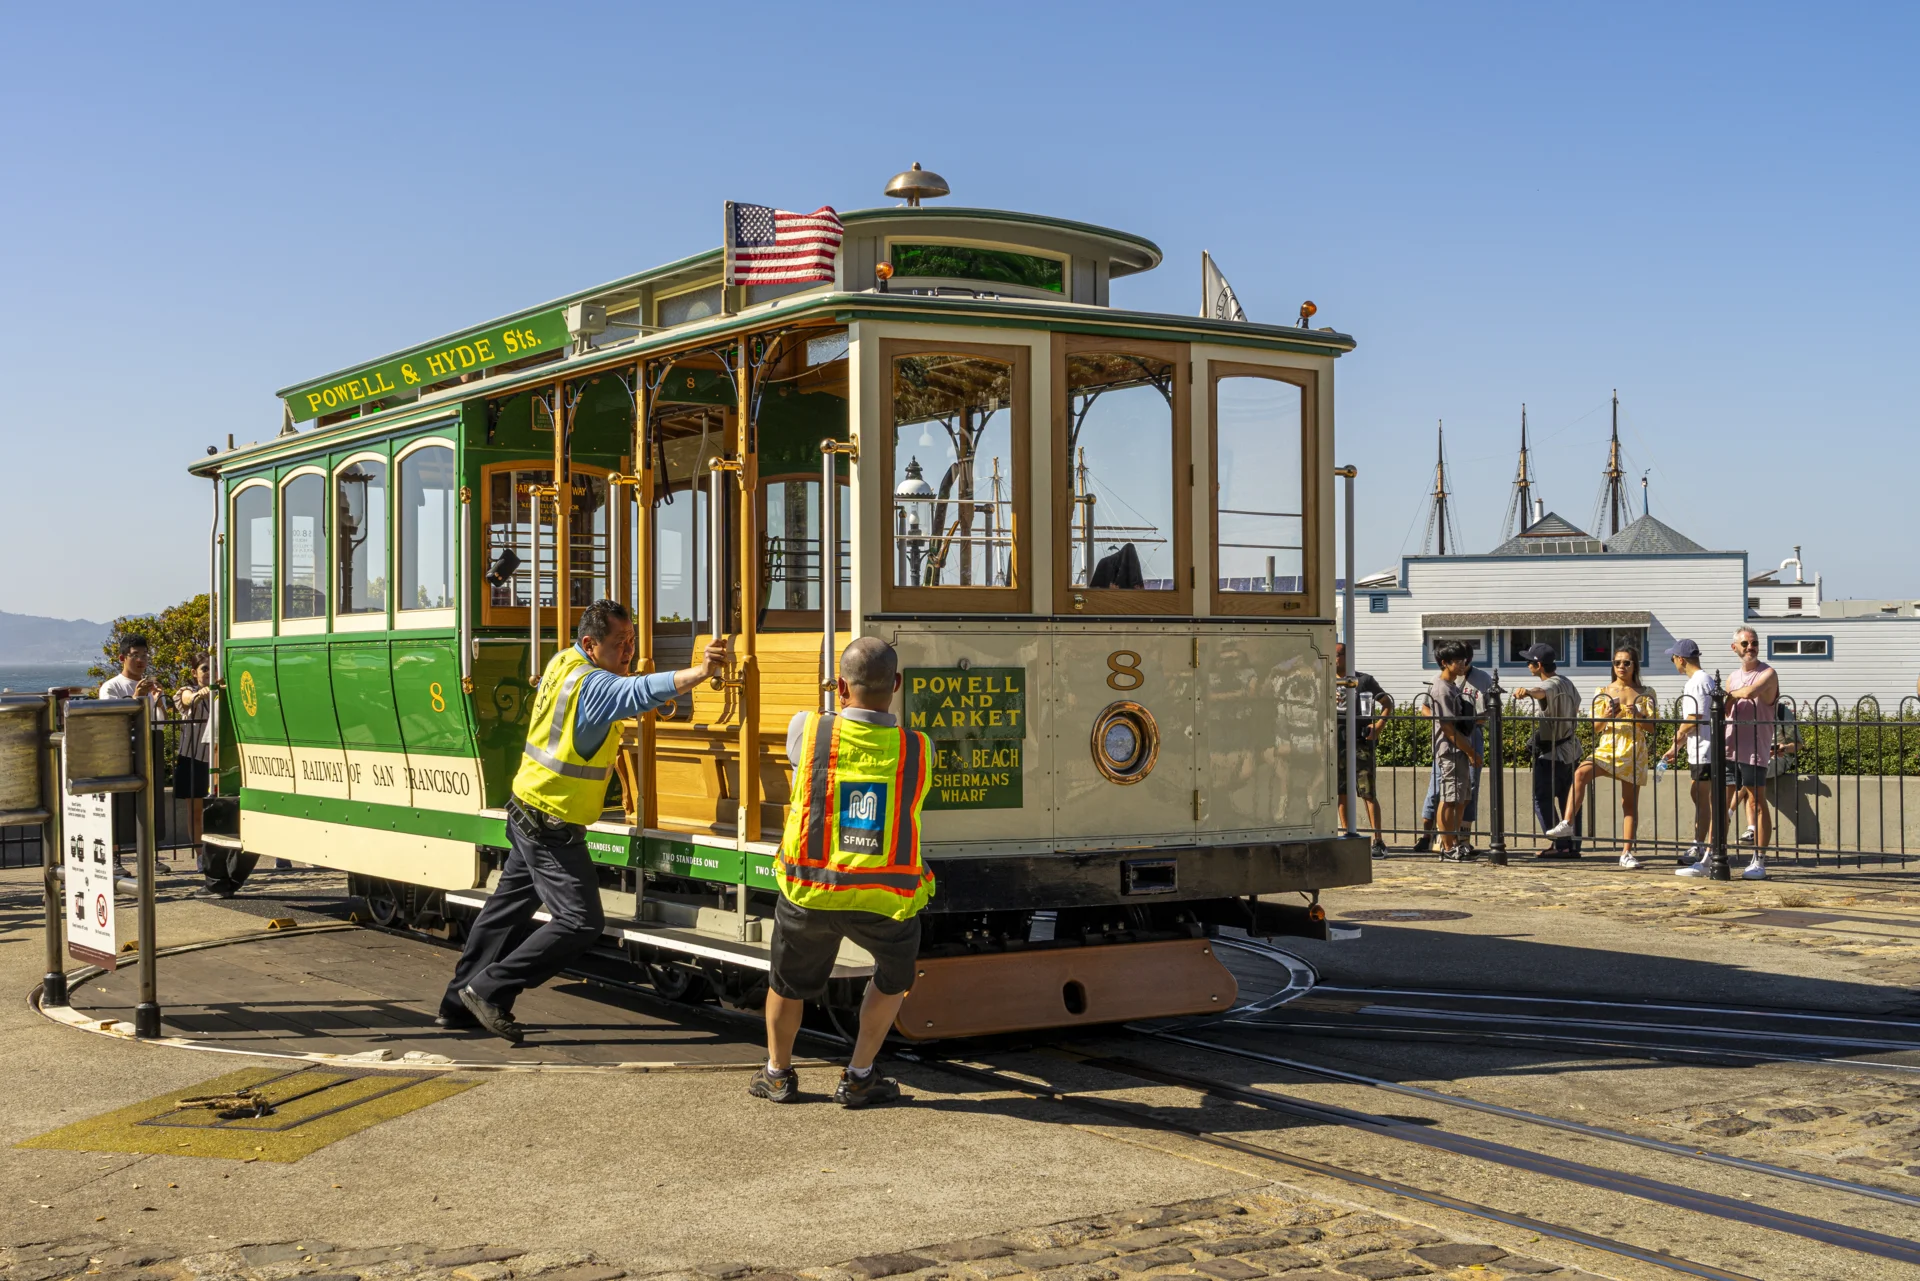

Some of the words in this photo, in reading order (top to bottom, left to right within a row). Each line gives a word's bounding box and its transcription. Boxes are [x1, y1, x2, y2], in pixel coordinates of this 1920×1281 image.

[306, 372, 395, 412] POWELL
[401, 363, 421, 385] &
[425, 338, 495, 377] HYDE
[503, 328, 542, 354] Sts.
[686, 377, 695, 389] 8
[1106, 649, 1145, 691] 8
[912, 676, 1019, 694] POWELL
[429, 681, 446, 713] 8
[940, 695, 993, 708] AND
[910, 709, 1021, 728] MARKET
[972, 748, 1019, 769] BEACH
[302, 760, 343, 783] RAILWAY
[349, 763, 361, 785] OF
[372, 764, 395, 788] SAN
[941, 788, 988, 803] WHARF
[587, 841, 611, 852] STANDEES
[612, 844, 625, 854] ONLY
[843, 835, 879, 848] SFMTA
[662, 852, 675, 861] TWO
[676, 854, 703, 867] STANDEES
[704, 858, 720, 869] ONLY
[755, 865, 770, 876] TWO
